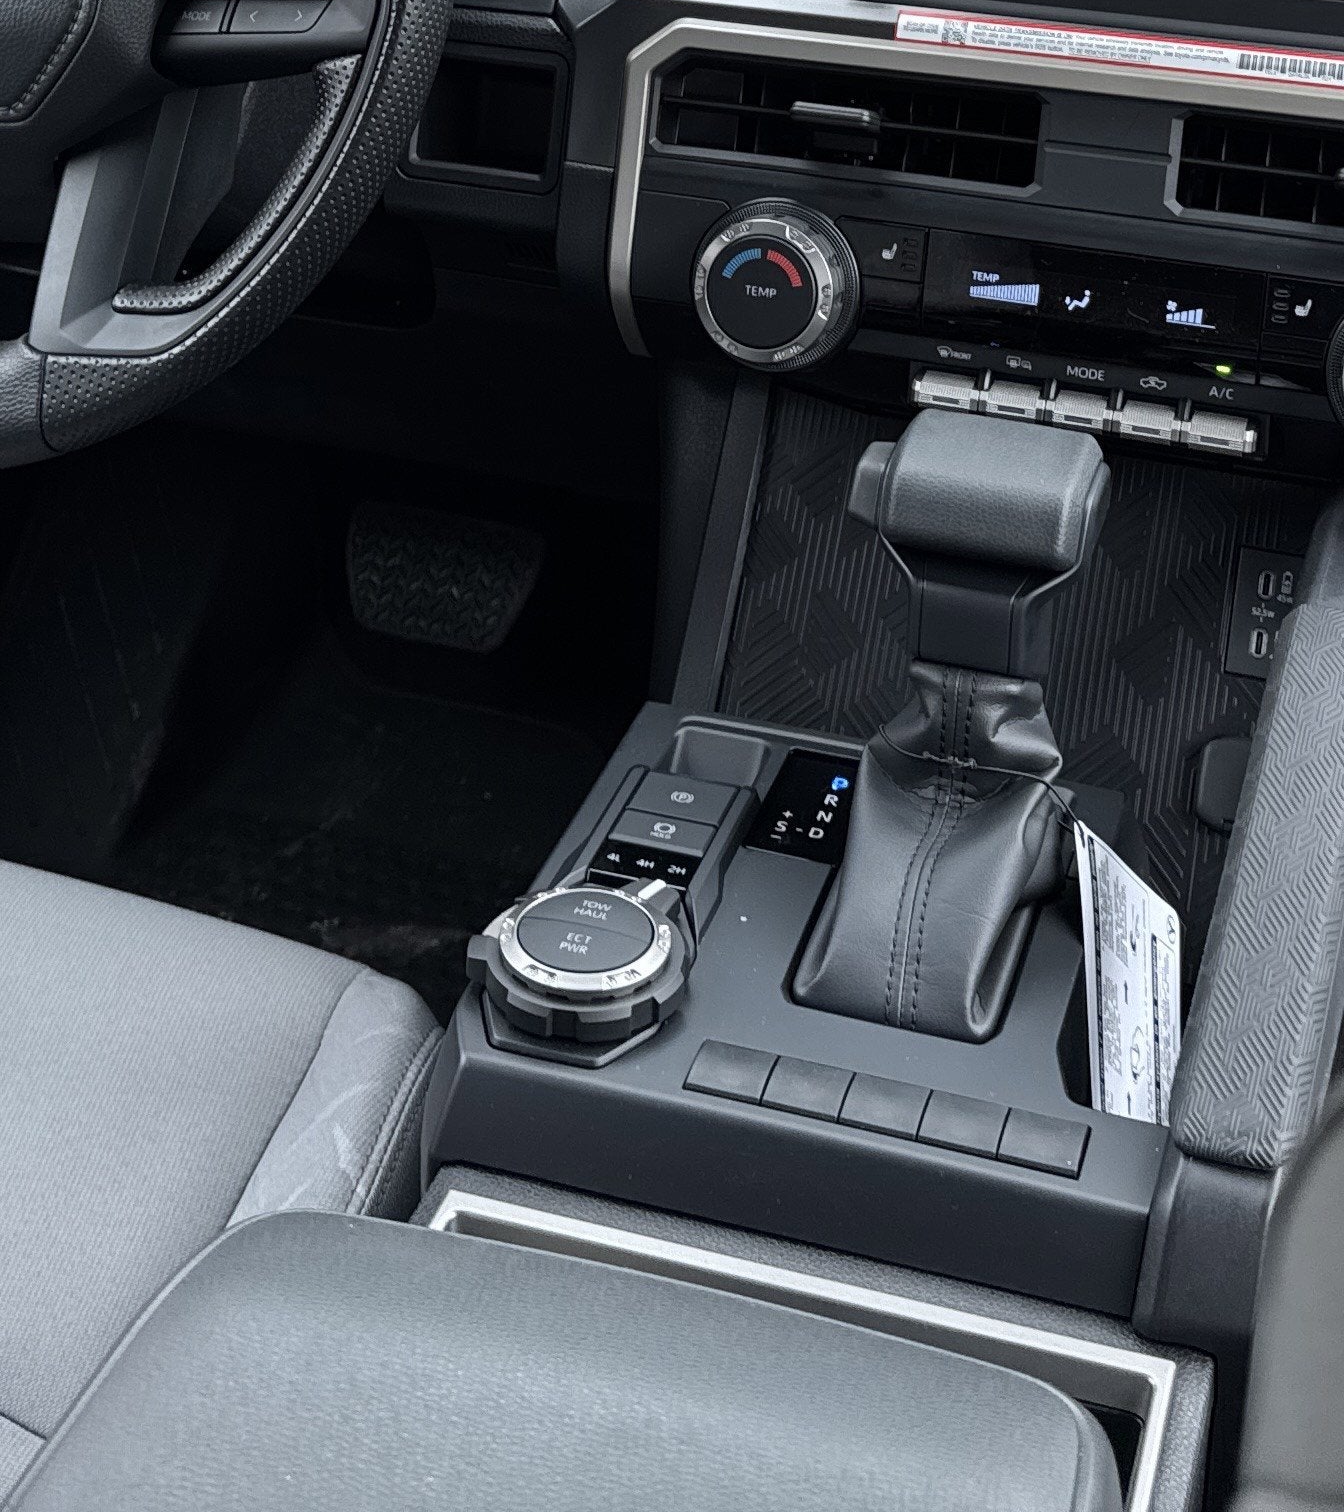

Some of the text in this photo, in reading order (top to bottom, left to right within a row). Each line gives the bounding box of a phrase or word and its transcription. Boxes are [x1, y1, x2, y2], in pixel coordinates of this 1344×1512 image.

[181, 10, 212, 21] MODE
[972, 270, 1000, 283] TEMP
[745, 284, 777, 299] TEMP
[1066, 364, 1105, 382] MODE
[1209, 385, 1235, 401] A/C
[831, 776, 849, 791] P
[824, 793, 839, 807] R
[816, 810, 833, 823] N
[774, 820, 789, 832] S
[808, 826, 825, 839] D
[582, 899, 613, 912] TOW
[573, 906, 608, 921] HAUL
[566, 932, 593, 945] ECT
[558, 941, 589, 955] PWR
